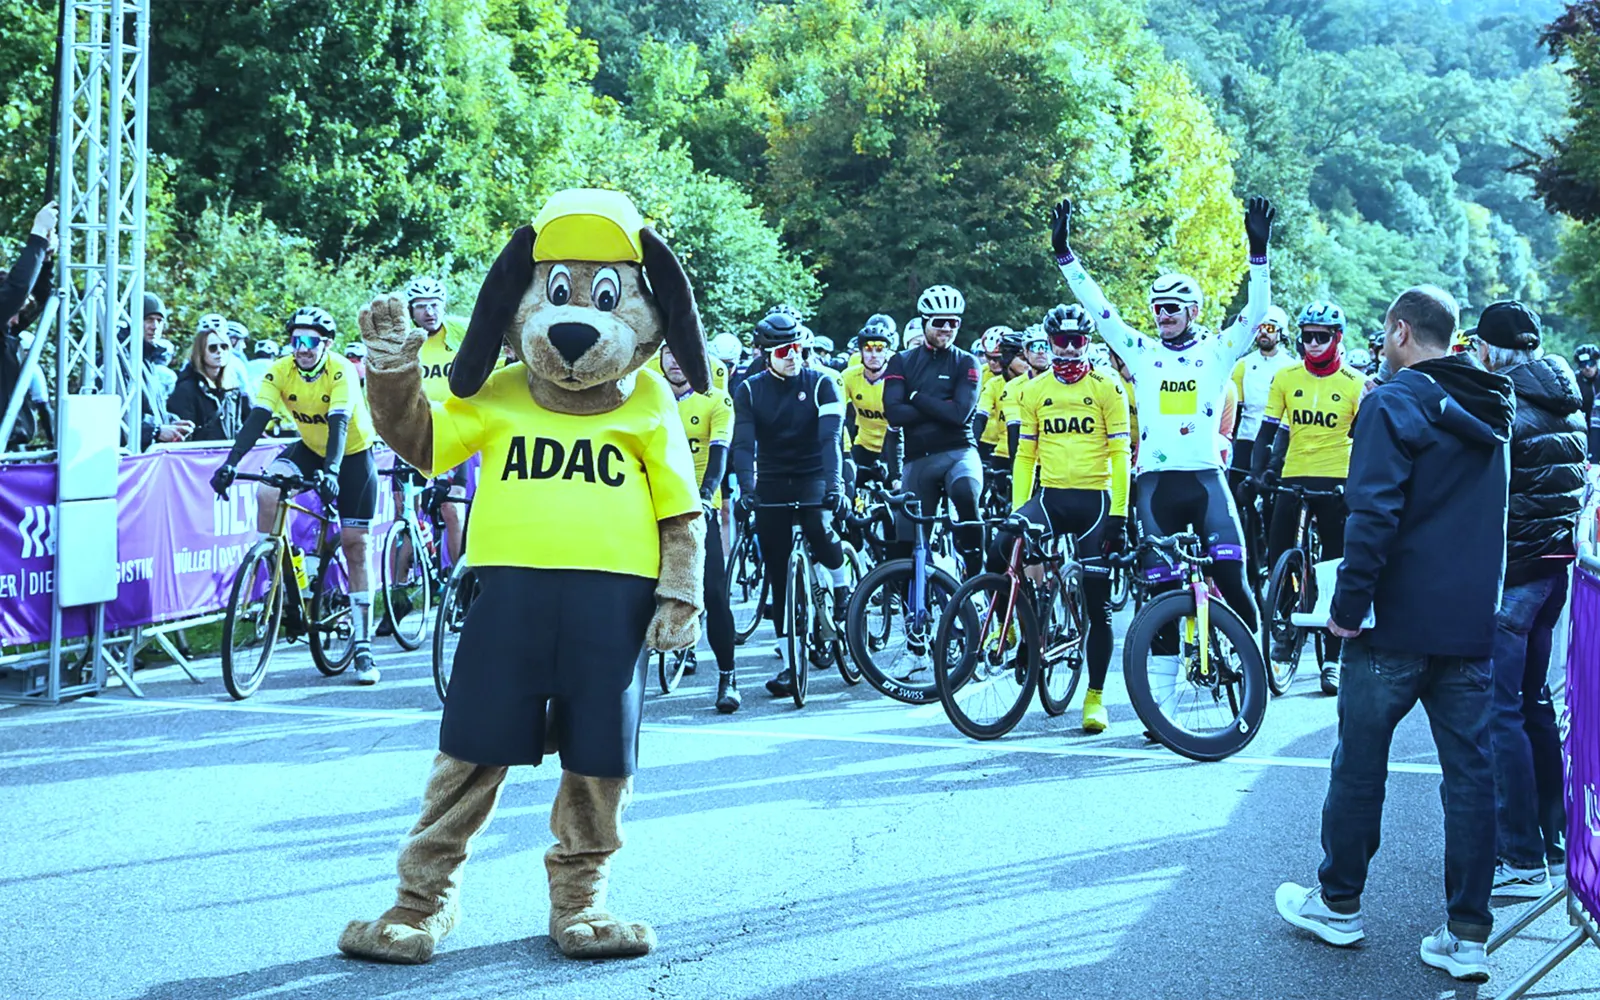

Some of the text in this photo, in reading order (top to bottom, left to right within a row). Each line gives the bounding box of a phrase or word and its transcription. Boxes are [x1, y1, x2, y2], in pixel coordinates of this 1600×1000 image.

[1160, 380, 1196, 392] ADAC
[292, 410, 328, 425] ADA
[858, 408, 887, 420] ADA
[1292, 409, 1338, 428] ADAC
[1043, 416, 1095, 434] ADAC
[500, 436, 625, 487] ADAC
[174, 547, 211, 574] MÜLLER
[29, 571, 53, 595] DIE
[882, 680, 924, 700] DT SWISS
